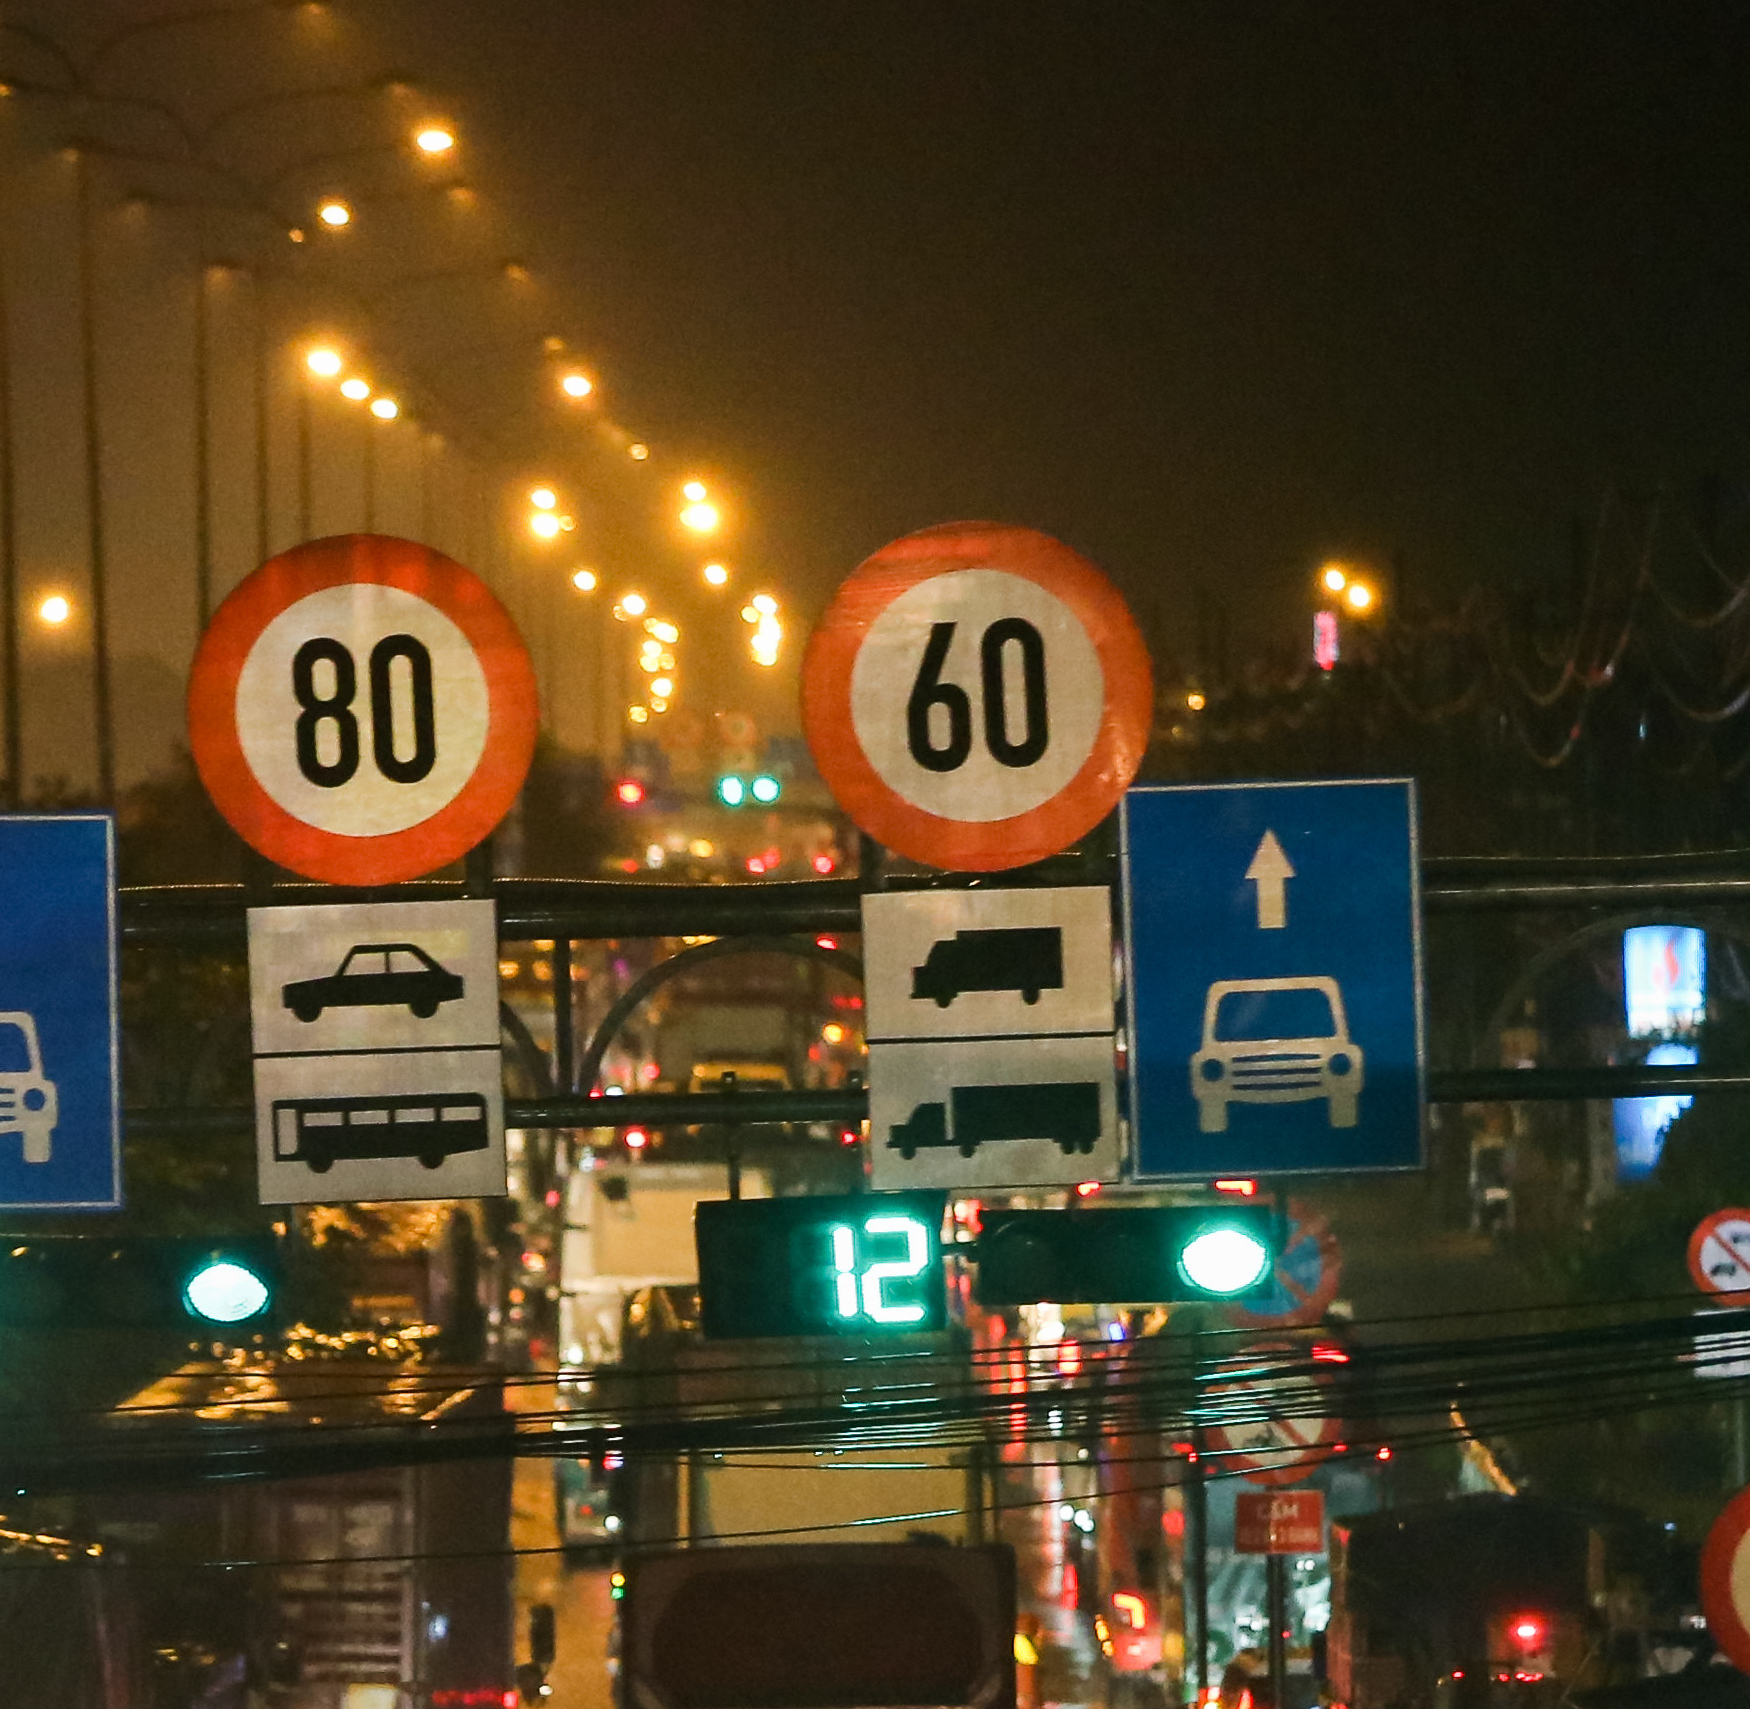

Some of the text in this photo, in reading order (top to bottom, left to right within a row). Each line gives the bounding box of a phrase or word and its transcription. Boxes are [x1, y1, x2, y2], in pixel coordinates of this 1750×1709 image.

[291, 633, 437, 788] 80
[907, 616, 1049, 774] 60
[833, 1215, 929, 1322] 12
